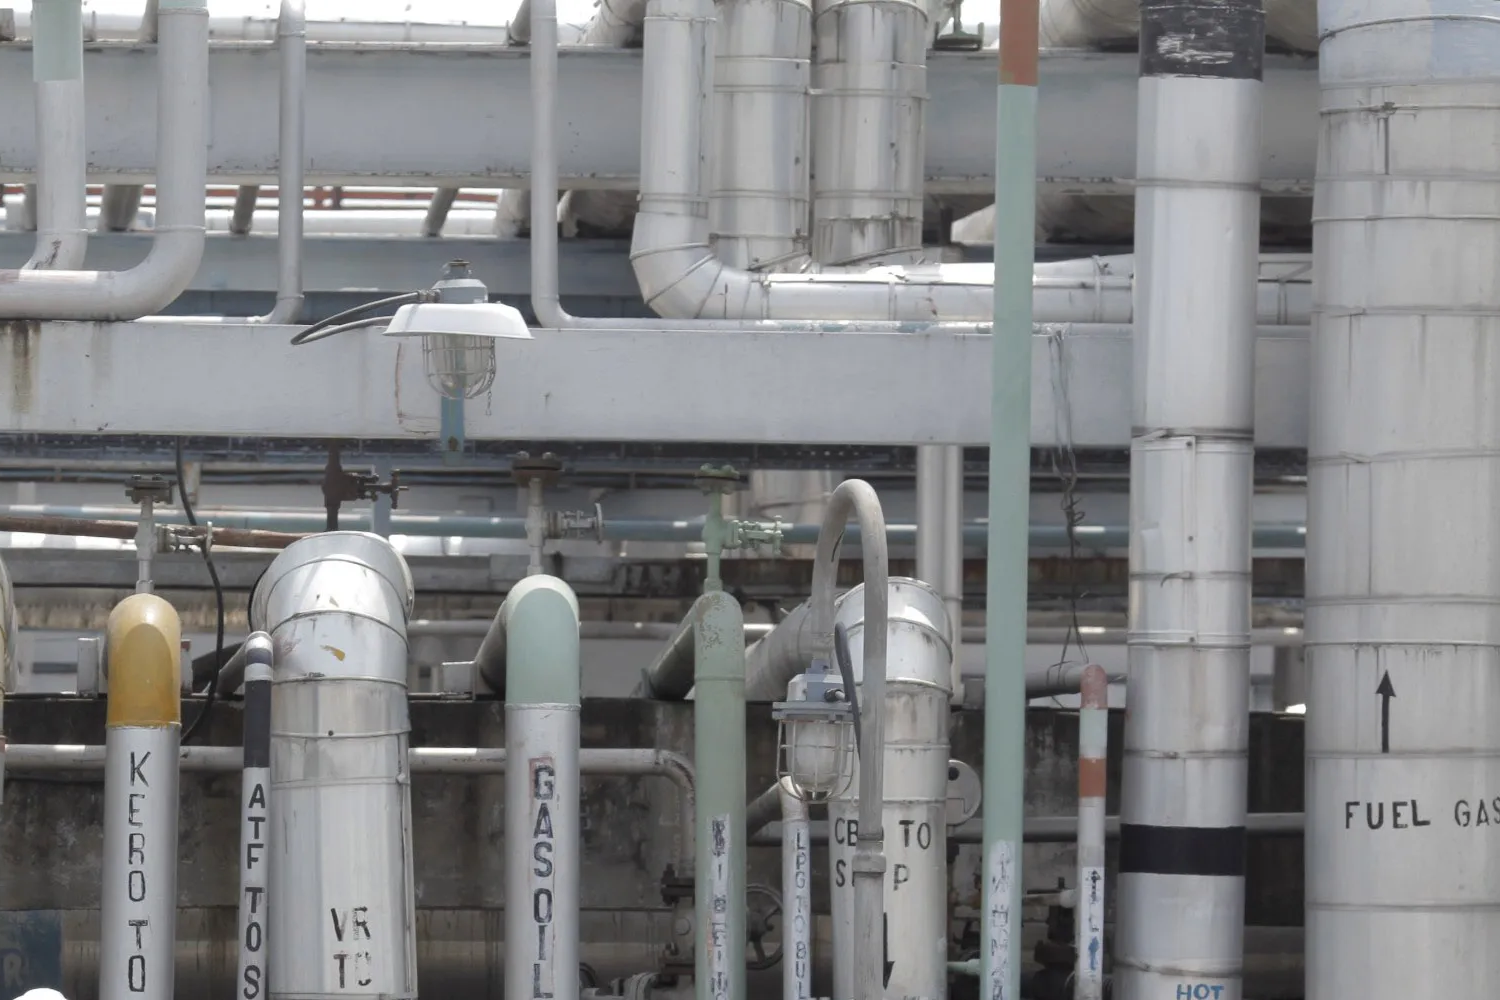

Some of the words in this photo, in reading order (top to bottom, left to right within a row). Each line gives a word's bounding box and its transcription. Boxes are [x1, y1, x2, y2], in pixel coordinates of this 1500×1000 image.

[127, 752, 151, 902] KERO
[247, 783, 266, 869] ATF
[533, 765, 555, 877] GAS
[834, 817, 885, 847] CB
[899, 820, 932, 850] TO
[1345, 799, 1431, 830] FUEL
[835, 858, 911, 892] SP
[245, 887, 265, 952] TO
[330, 905, 371, 942] VR
[533, 888, 554, 998] OIL
[127, 919, 149, 992] TO
[1176, 983, 1225, 1000] HOT
